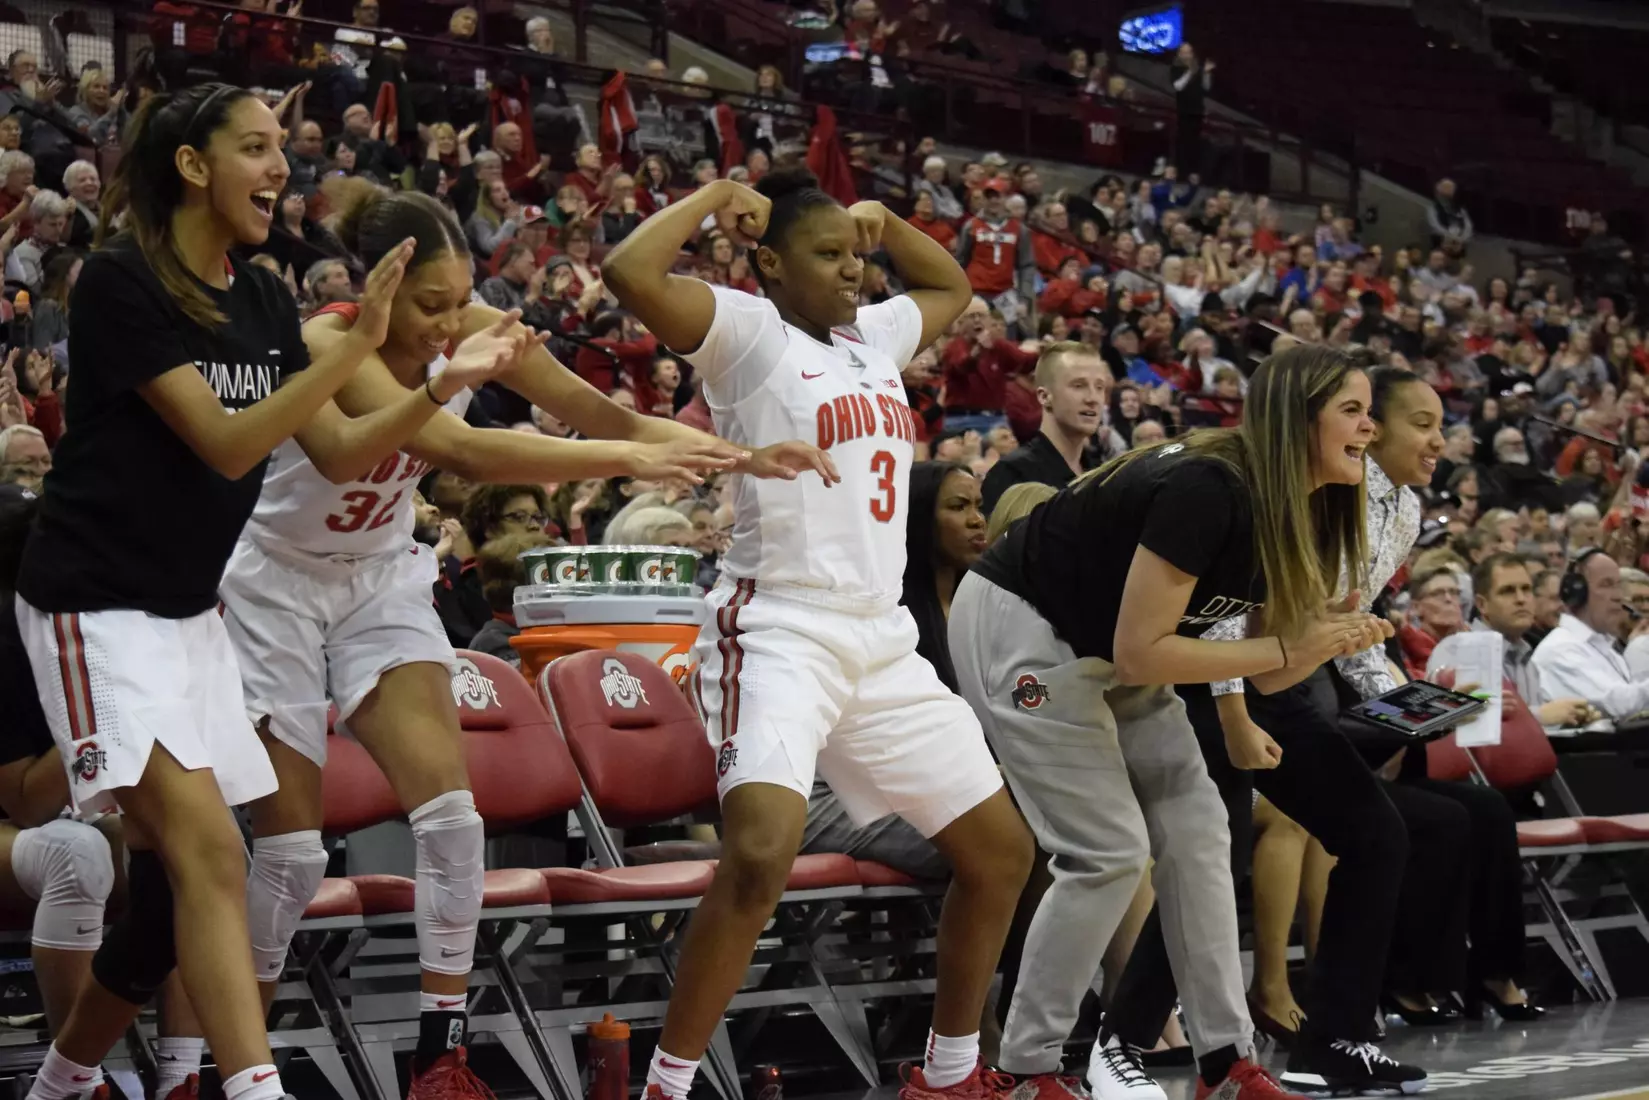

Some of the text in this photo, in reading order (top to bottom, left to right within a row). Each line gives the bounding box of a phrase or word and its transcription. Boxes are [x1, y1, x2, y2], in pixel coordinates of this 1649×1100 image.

[817, 392, 877, 451] OHIO
[869, 450, 897, 524] 3
[556, 560, 577, 583] G
[641, 559, 662, 582] G
[463, 670, 502, 708] STATE
[613, 670, 650, 706] STATE
